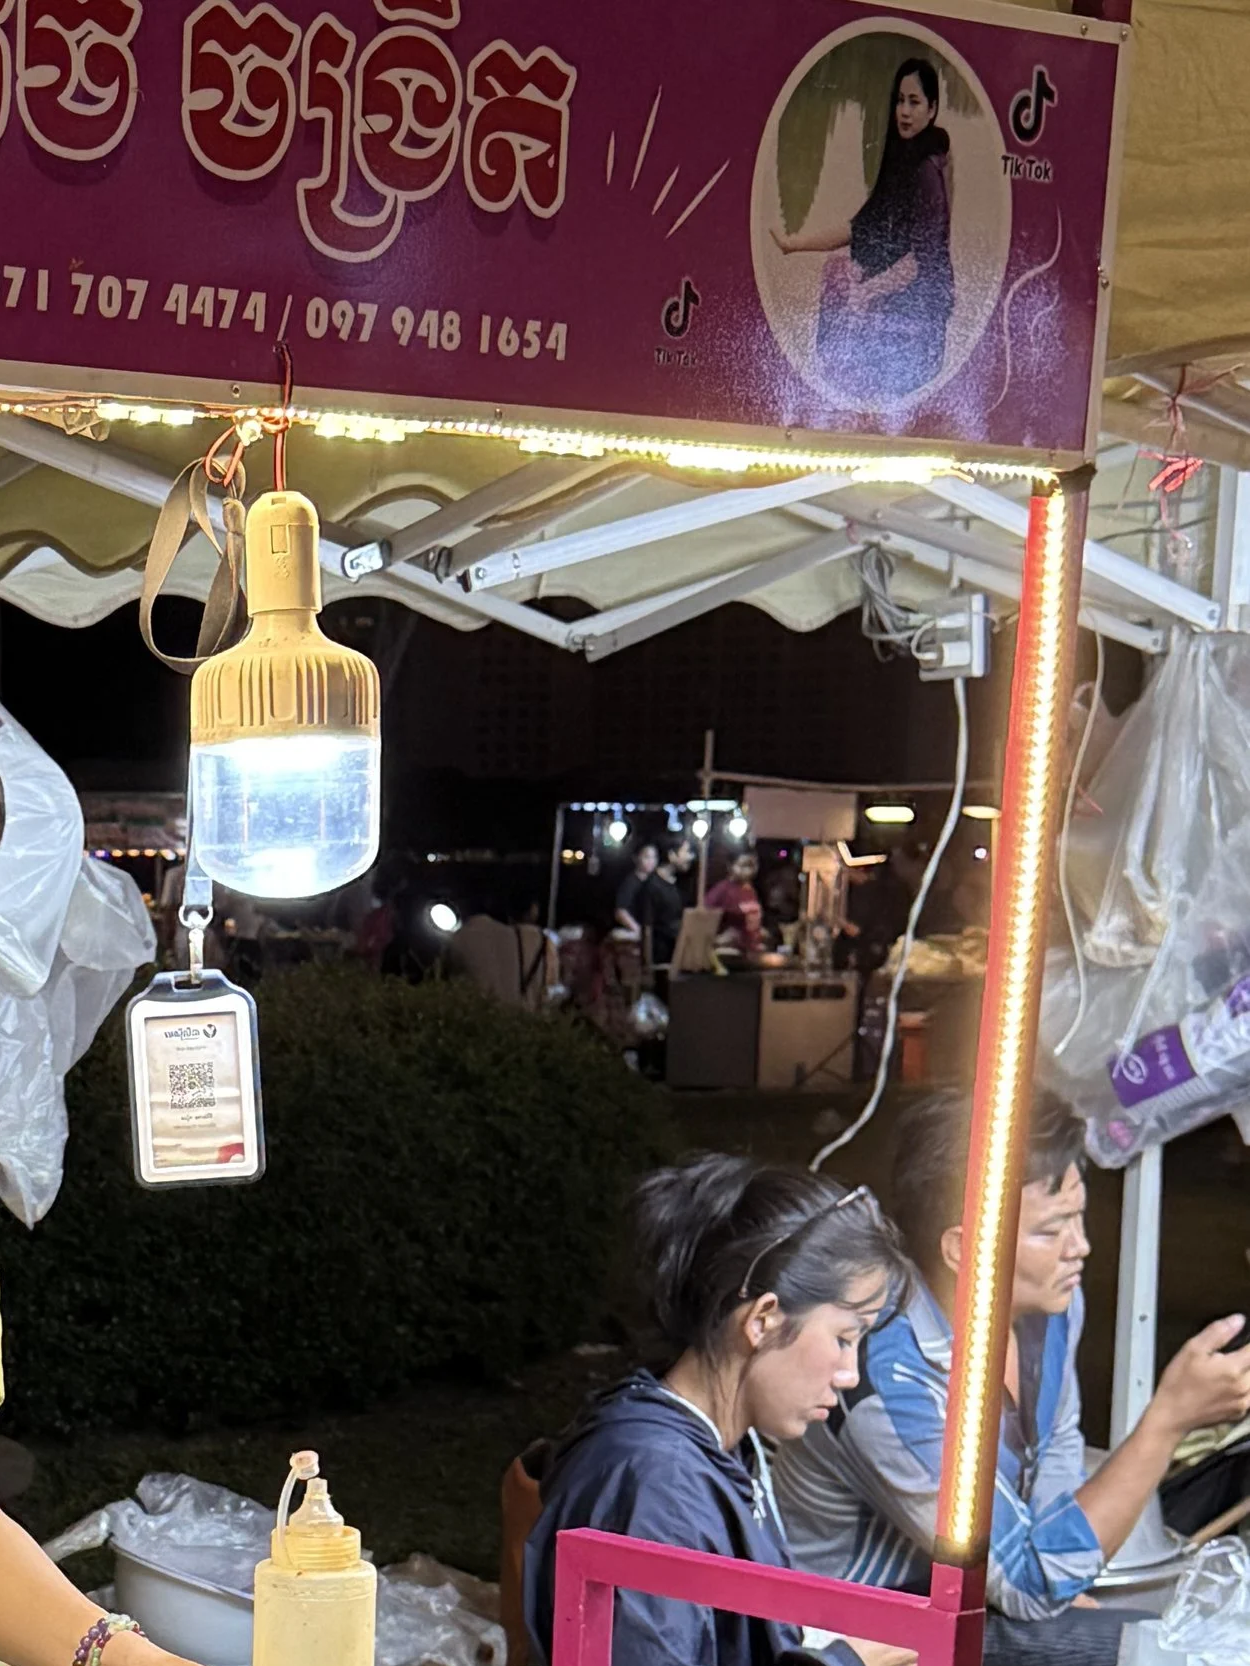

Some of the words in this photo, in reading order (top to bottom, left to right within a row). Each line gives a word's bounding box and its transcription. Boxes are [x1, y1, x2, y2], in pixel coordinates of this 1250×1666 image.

[70, 273, 149, 321] 707
[162, 283, 267, 334] 4474
[305, 296, 376, 345] 097
[391, 307, 462, 352] 948
[479, 314, 568, 362] 1654
